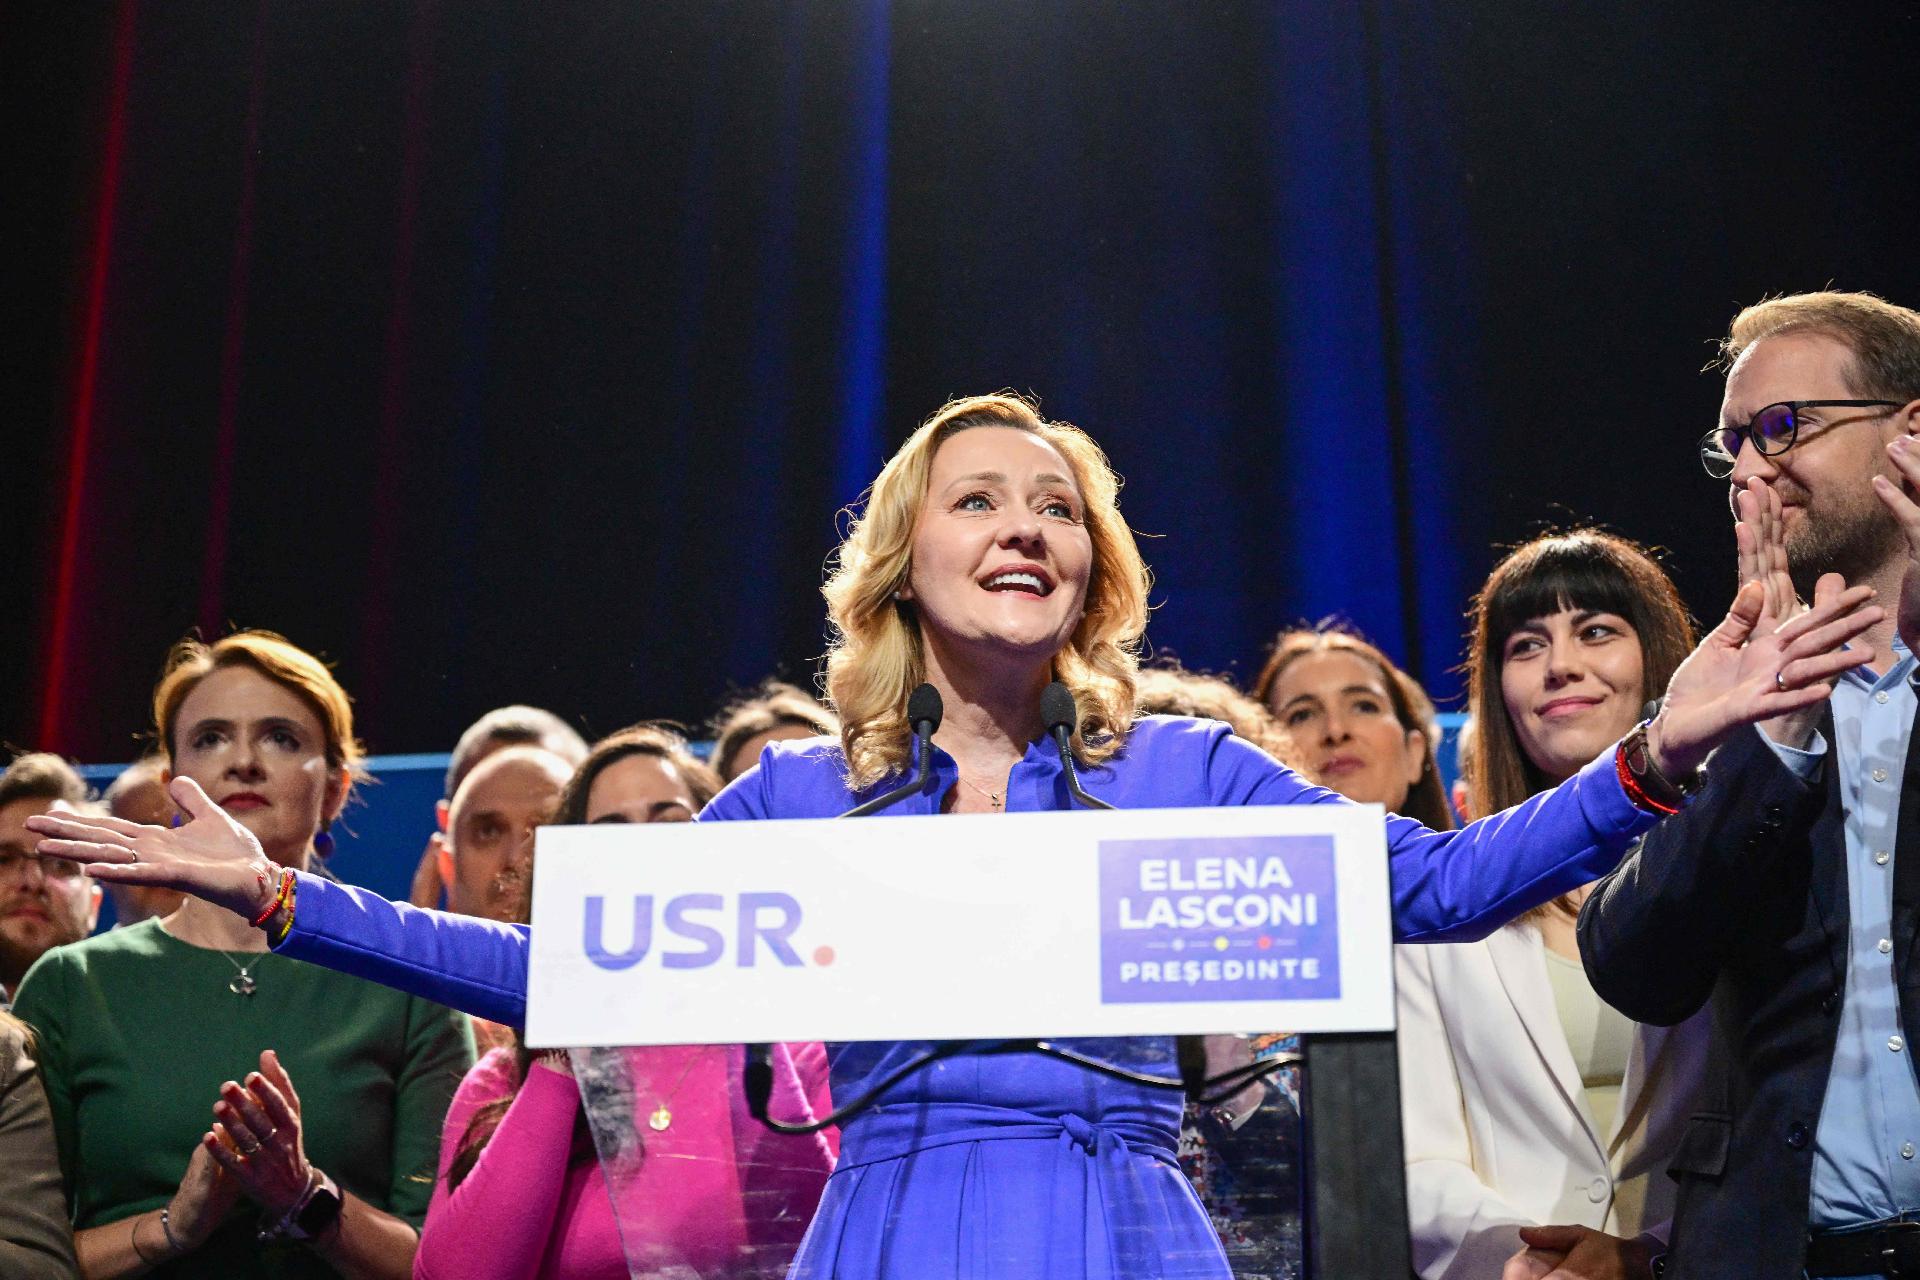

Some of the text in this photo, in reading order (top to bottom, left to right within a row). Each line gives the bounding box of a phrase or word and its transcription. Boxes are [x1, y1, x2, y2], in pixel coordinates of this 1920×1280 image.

[1140, 856, 1293, 891] ELENA
[1119, 893, 1317, 929] LASCONI
[1119, 958, 1320, 986] PREȘEDINTE
